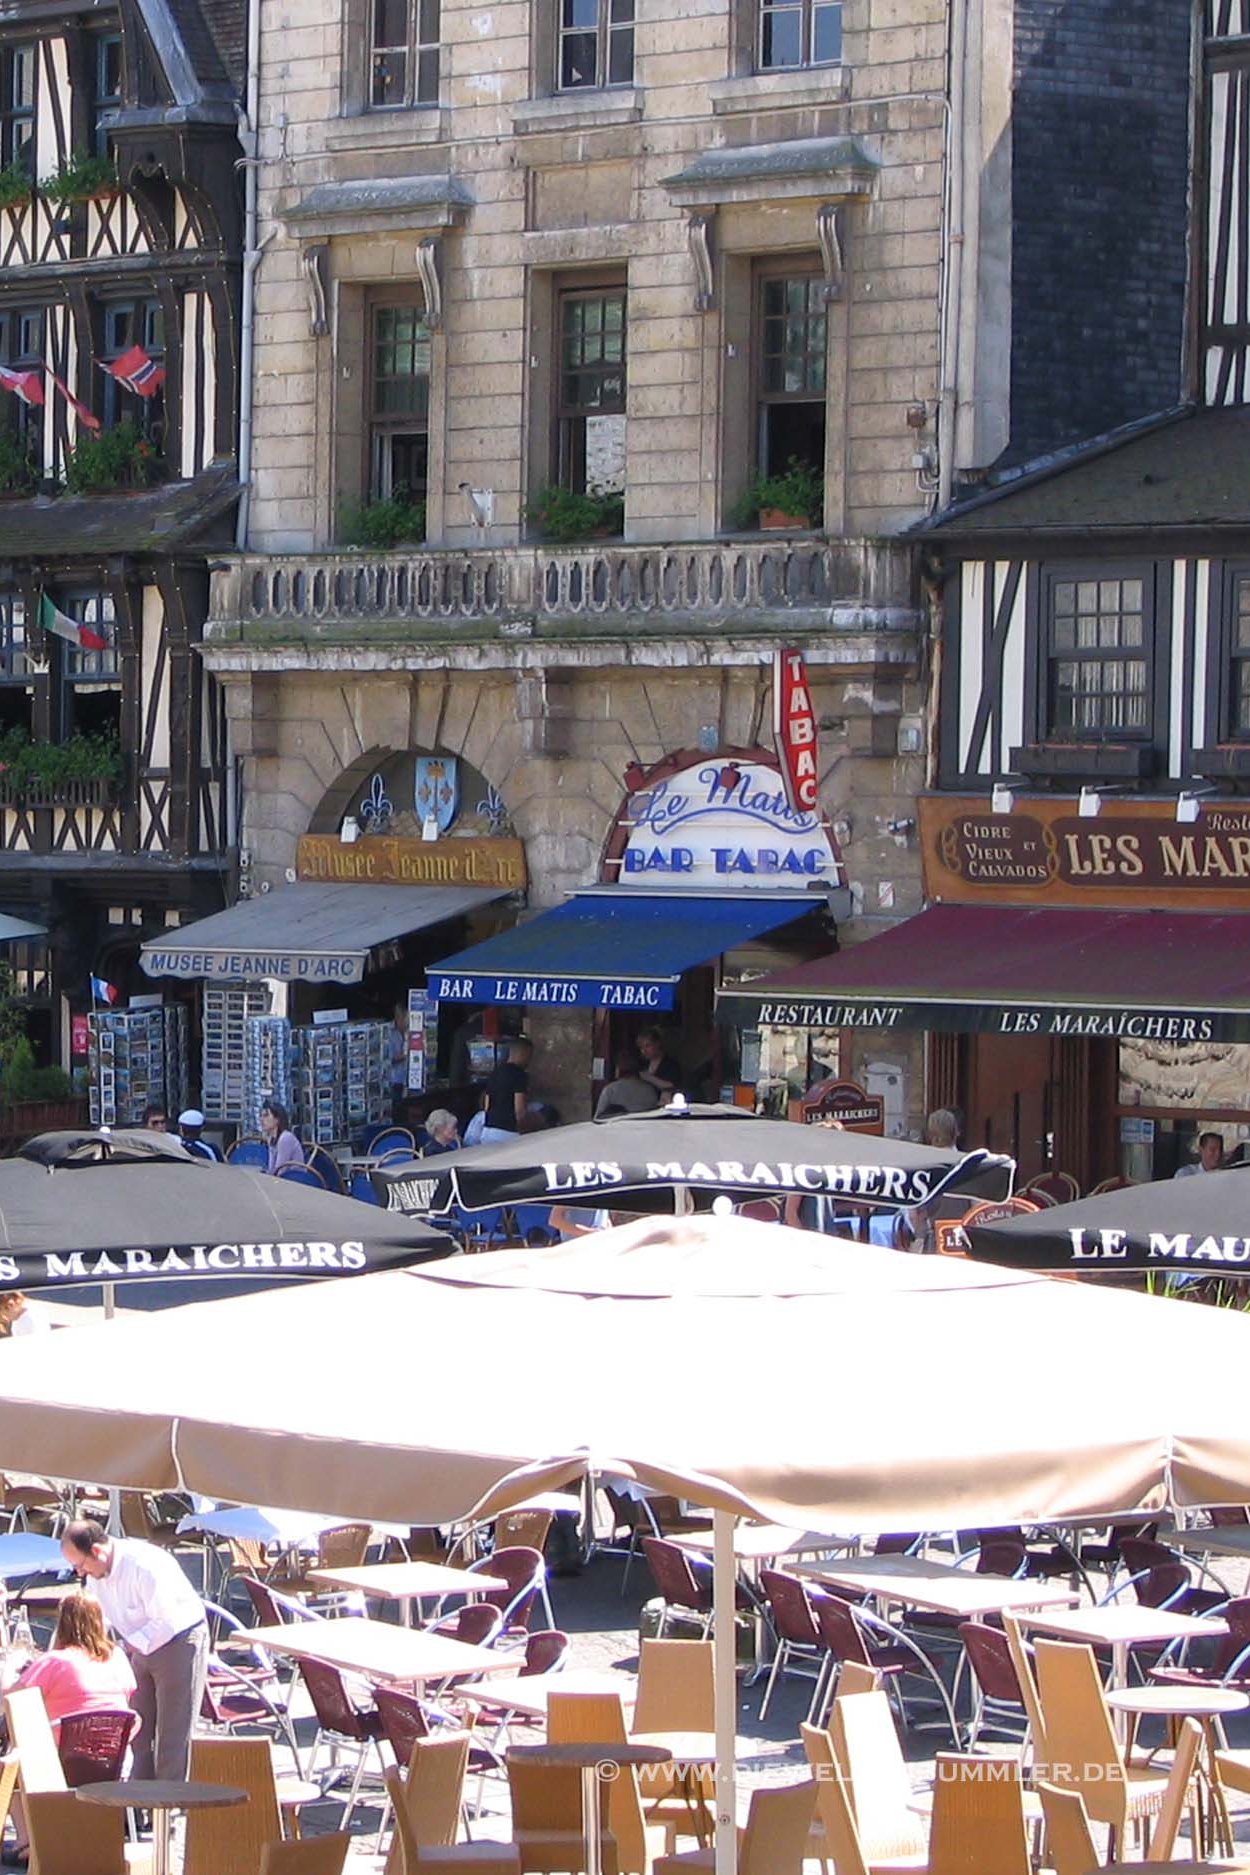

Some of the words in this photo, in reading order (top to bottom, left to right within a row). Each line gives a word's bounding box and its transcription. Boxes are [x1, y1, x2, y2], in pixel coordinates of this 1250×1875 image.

[788, 656, 817, 805] TABAC
[628, 782, 690, 828] Le
[699, 767, 817, 827] Matis
[963, 822, 1011, 839] CIDRE
[1207, 812, 1250, 831] Rest
[301, 838, 376, 878] Musée
[381, 841, 459, 880] Jeanne
[624, 848, 695, 874] BAR
[710, 848, 827, 875] TABAC
[966, 843, 1013, 861] VIEUX
[1064, 834, 1143, 876] LES
[1158, 836, 1250, 877] MAR
[969, 861, 1047, 878] CALVADOS
[151, 954, 214, 971] MUSEE
[218, 955, 291, 975] JEANNE
[297, 958, 354, 976] D'ARC
[439, 979, 473, 998] BAR
[495, 981, 518, 1000] LE
[522, 982, 578, 1002] MATIS
[600, 984, 659, 1006] TABAC
[758, 1003, 903, 1027] RESTAURANT
[999, 1012, 1041, 1032] LES
[541, 1162, 622, 1192] LES
[645, 1161, 931, 1203] MARAICHERS
[46, 1240, 367, 1278] MARAICHERS
[1069, 1228, 1127, 1259] LE
[1148, 1233, 1250, 1262] MAU
